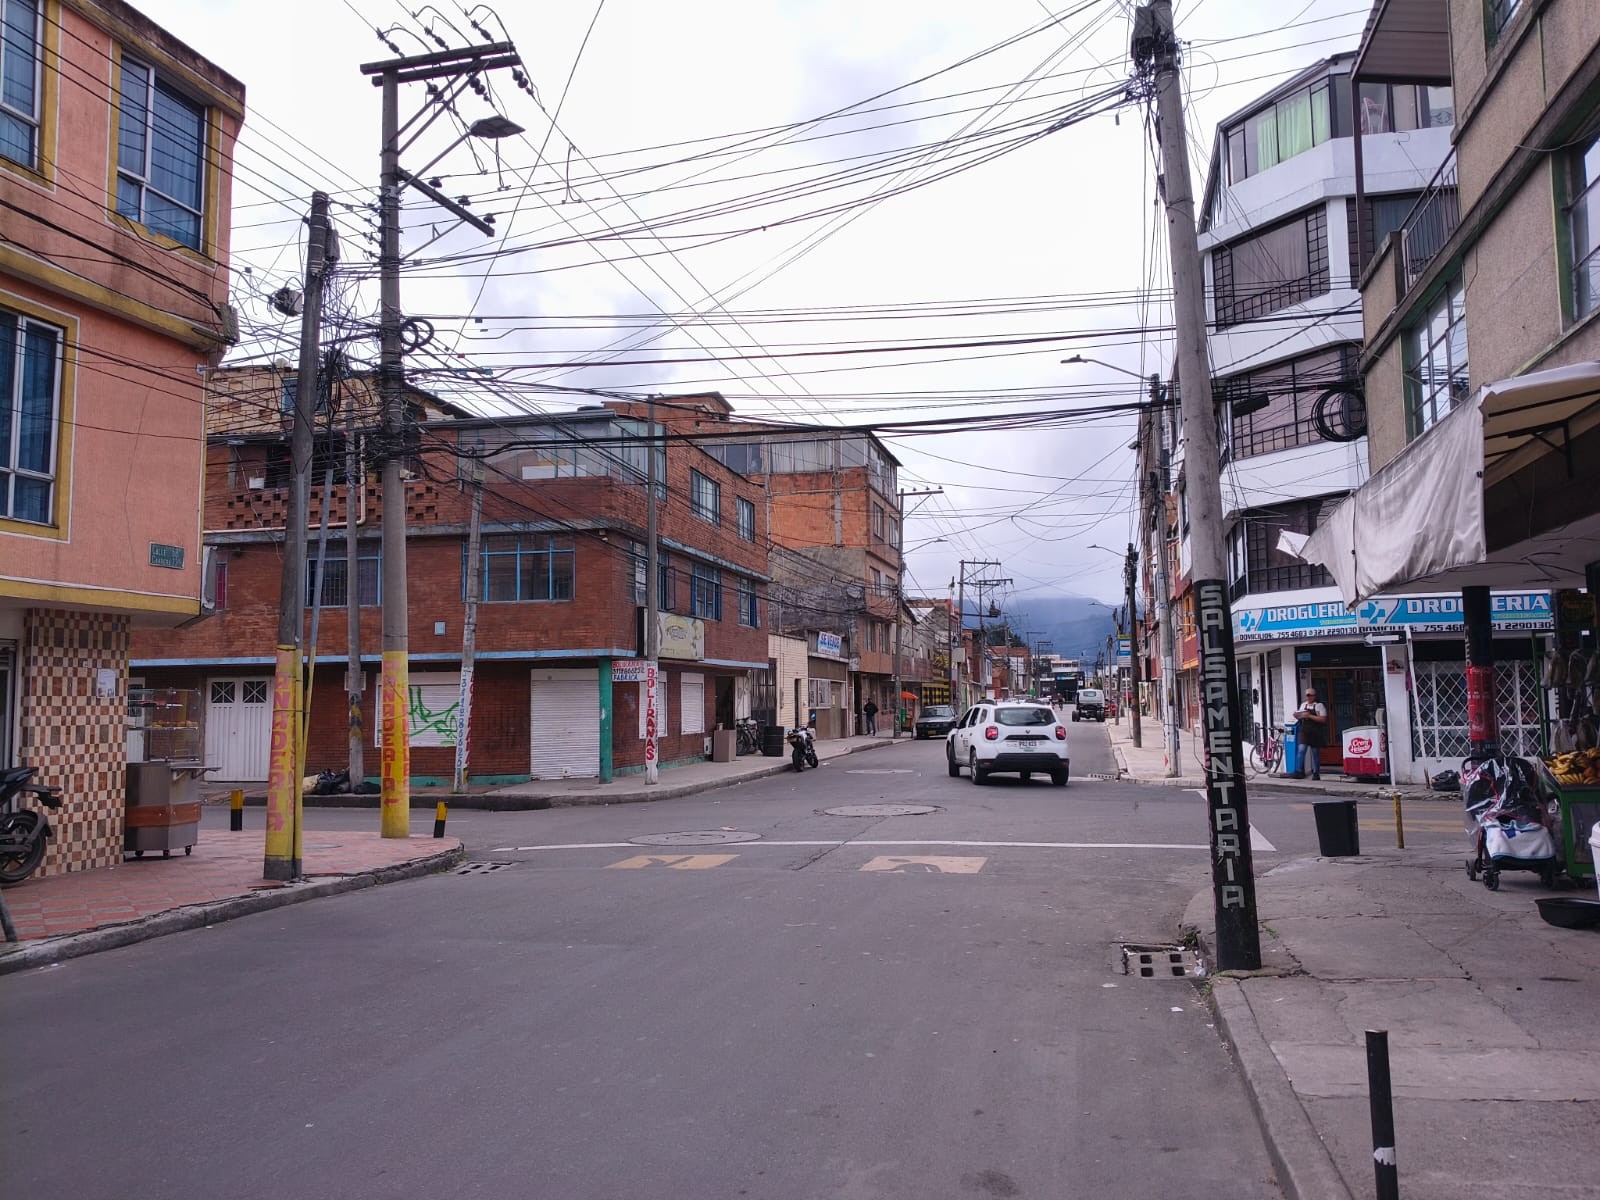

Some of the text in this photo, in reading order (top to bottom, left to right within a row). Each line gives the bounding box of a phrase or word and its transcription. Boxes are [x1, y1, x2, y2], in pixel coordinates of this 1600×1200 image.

[1407, 596, 1549, 613] DROERIA
[1277, 631, 1290, 639] 755
[1313, 629, 1326, 637] 321
[647, 667, 656, 761] BOLIRANAS
[1201, 585, 1246, 909] SALSAMENTARIA
